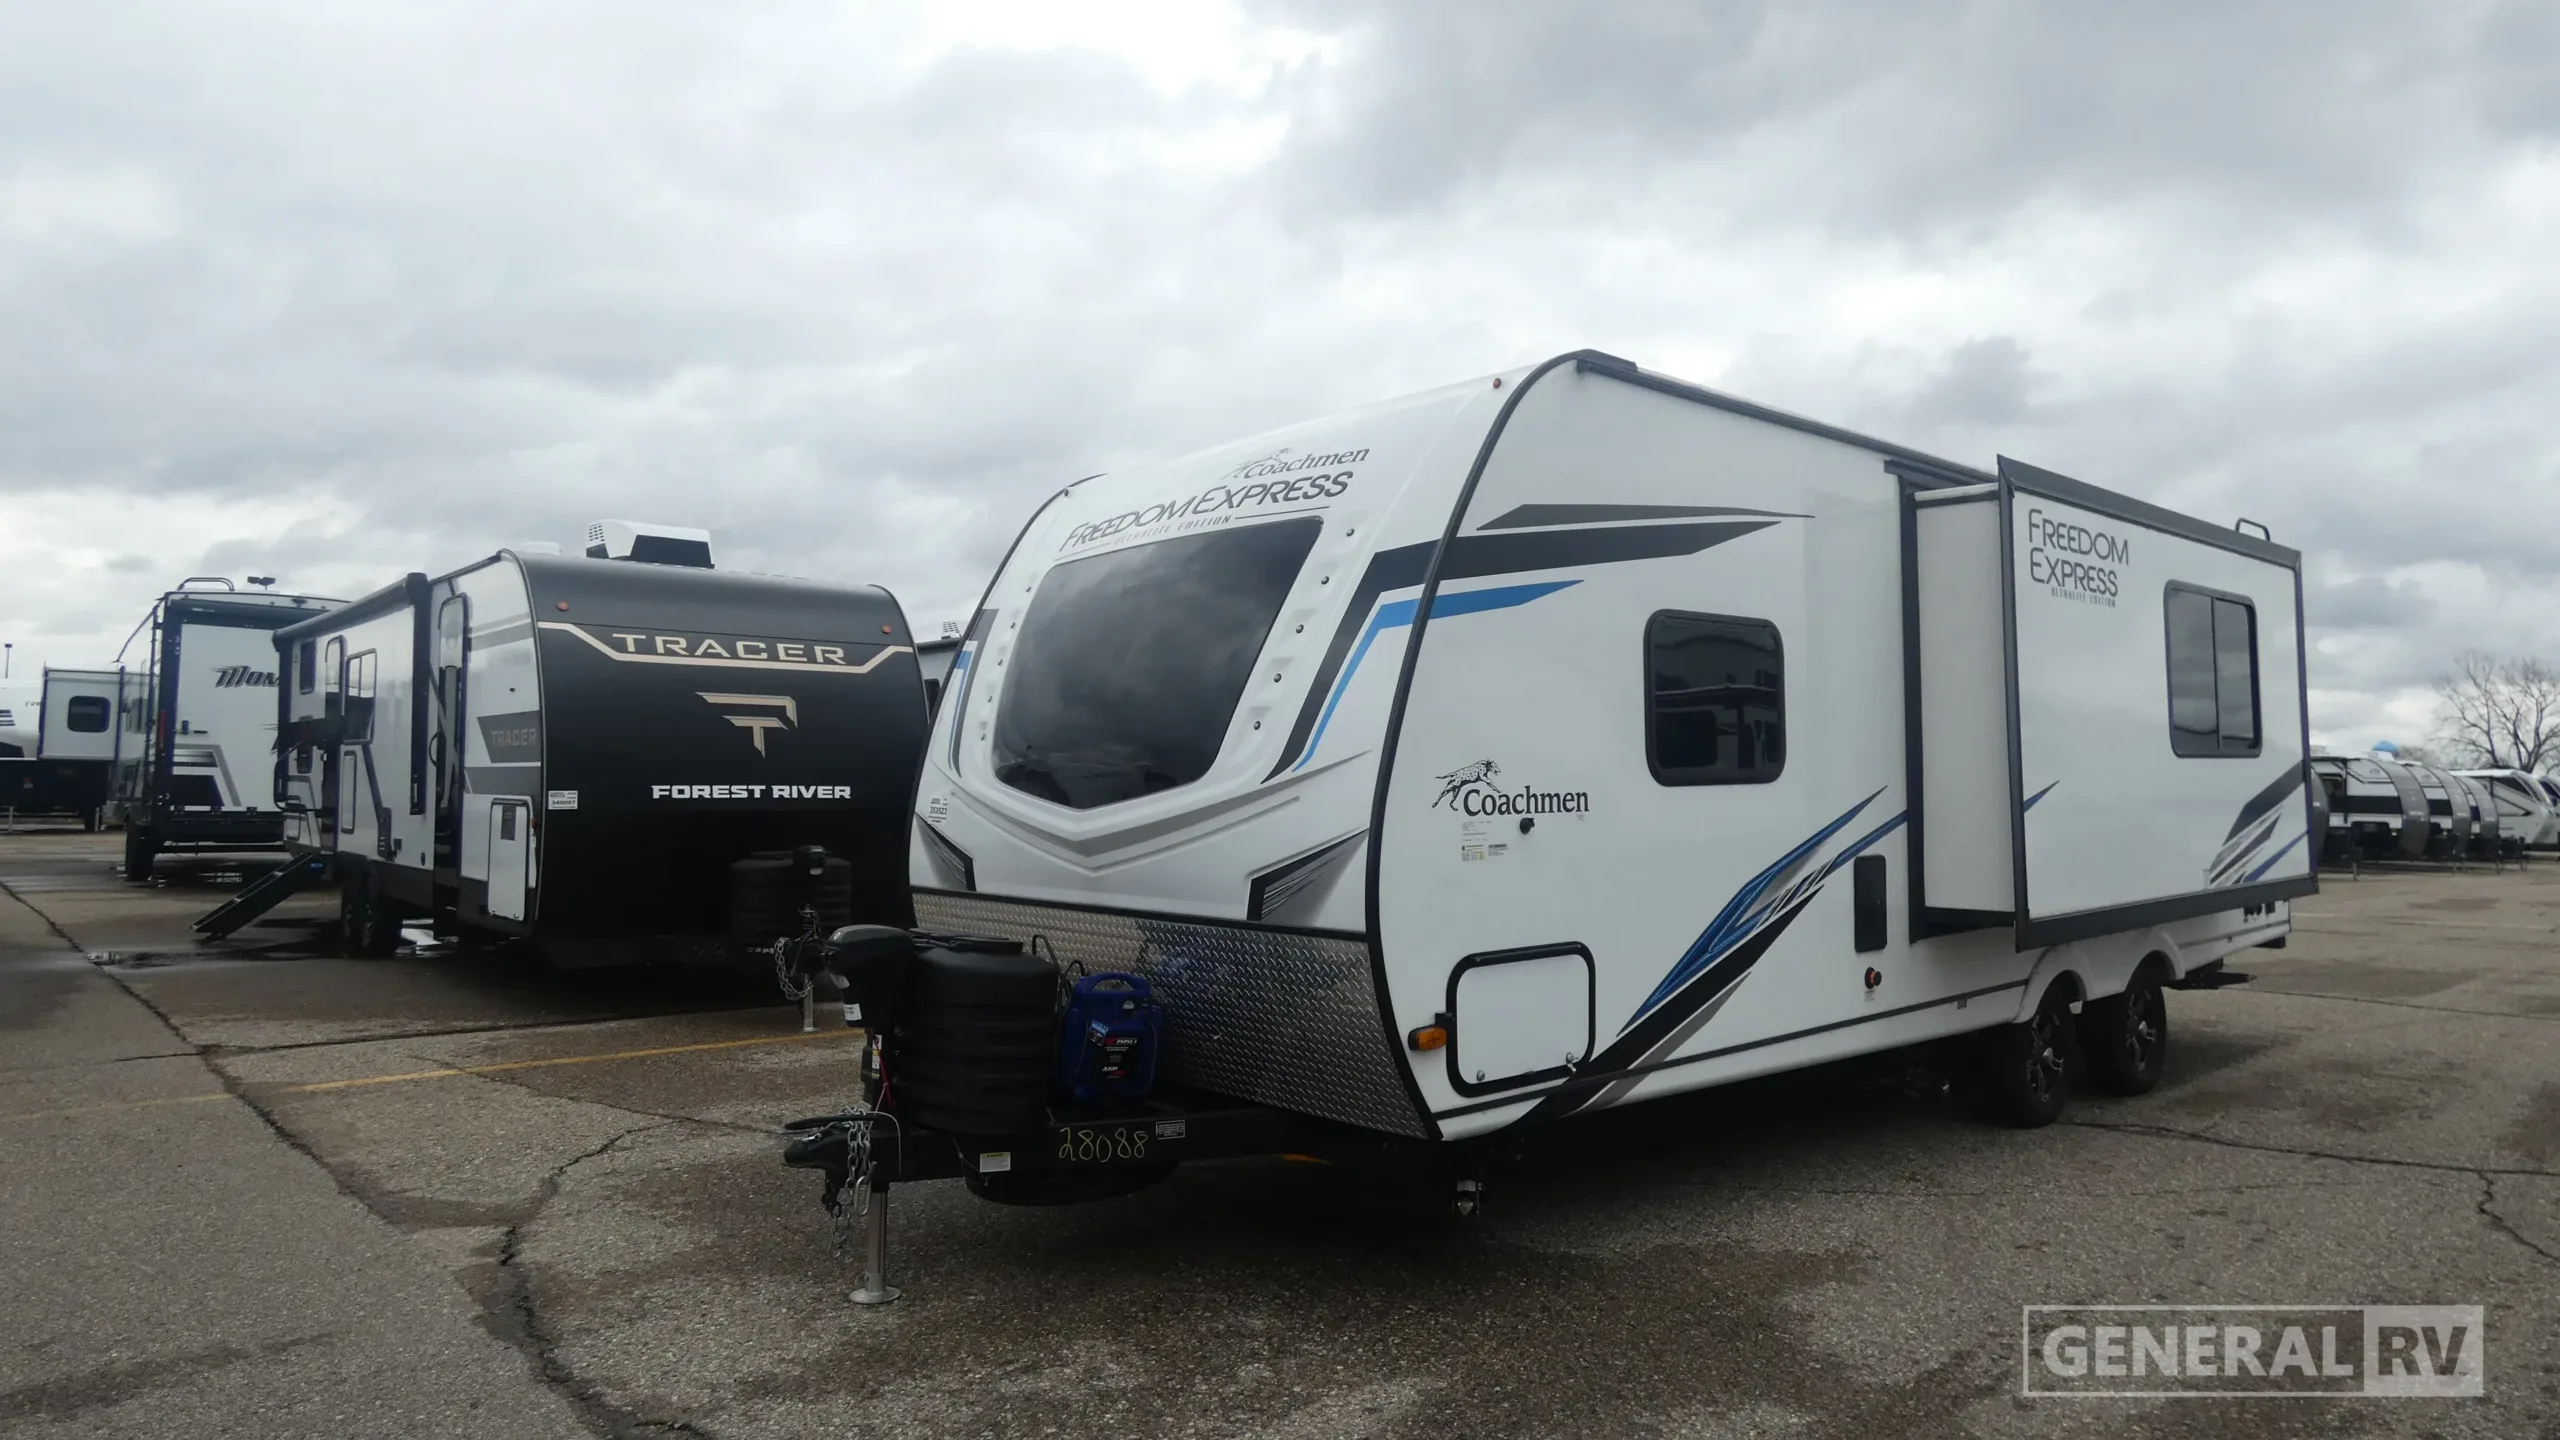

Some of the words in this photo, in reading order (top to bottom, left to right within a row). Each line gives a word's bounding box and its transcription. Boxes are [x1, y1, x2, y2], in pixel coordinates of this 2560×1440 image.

[1244, 448, 1370, 479] Coachmen
[1059, 496, 1197, 551] FREEDOM
[1192, 471, 1353, 515] EXPRESS
[1177, 515, 1231, 531] EDITION
[2029, 508, 2129, 566] FREEDOM
[2030, 547, 2118, 597] EXPRESS
[612, 633, 847, 665] TRACER
[651, 785, 766, 799] FOREST
[771, 785, 851, 799] RIVER
[1463, 785, 1590, 817] Coachmen
[1059, 1127, 1148, 1162] 28088
